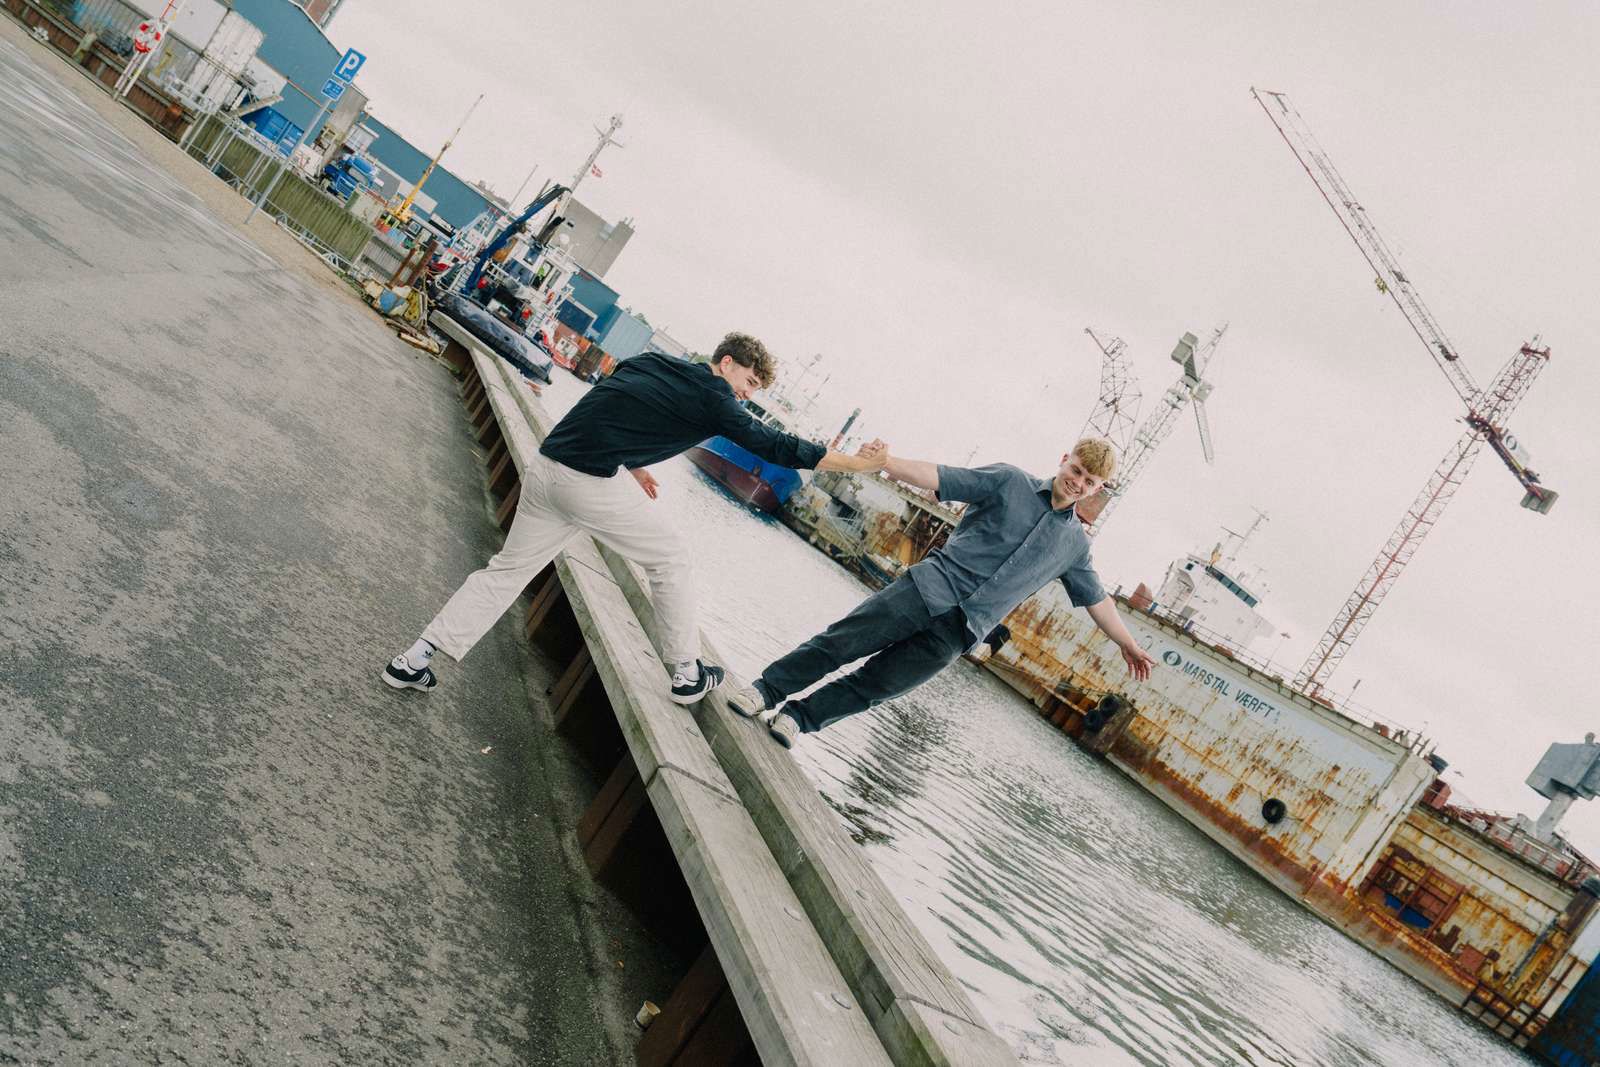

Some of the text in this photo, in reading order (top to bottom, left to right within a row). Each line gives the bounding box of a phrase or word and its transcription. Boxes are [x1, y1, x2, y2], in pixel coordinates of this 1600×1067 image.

[339, 53, 359, 74] P
[1182, 661, 1229, 696] MARSTAL
[1234, 689, 1275, 717] VÆRFT
